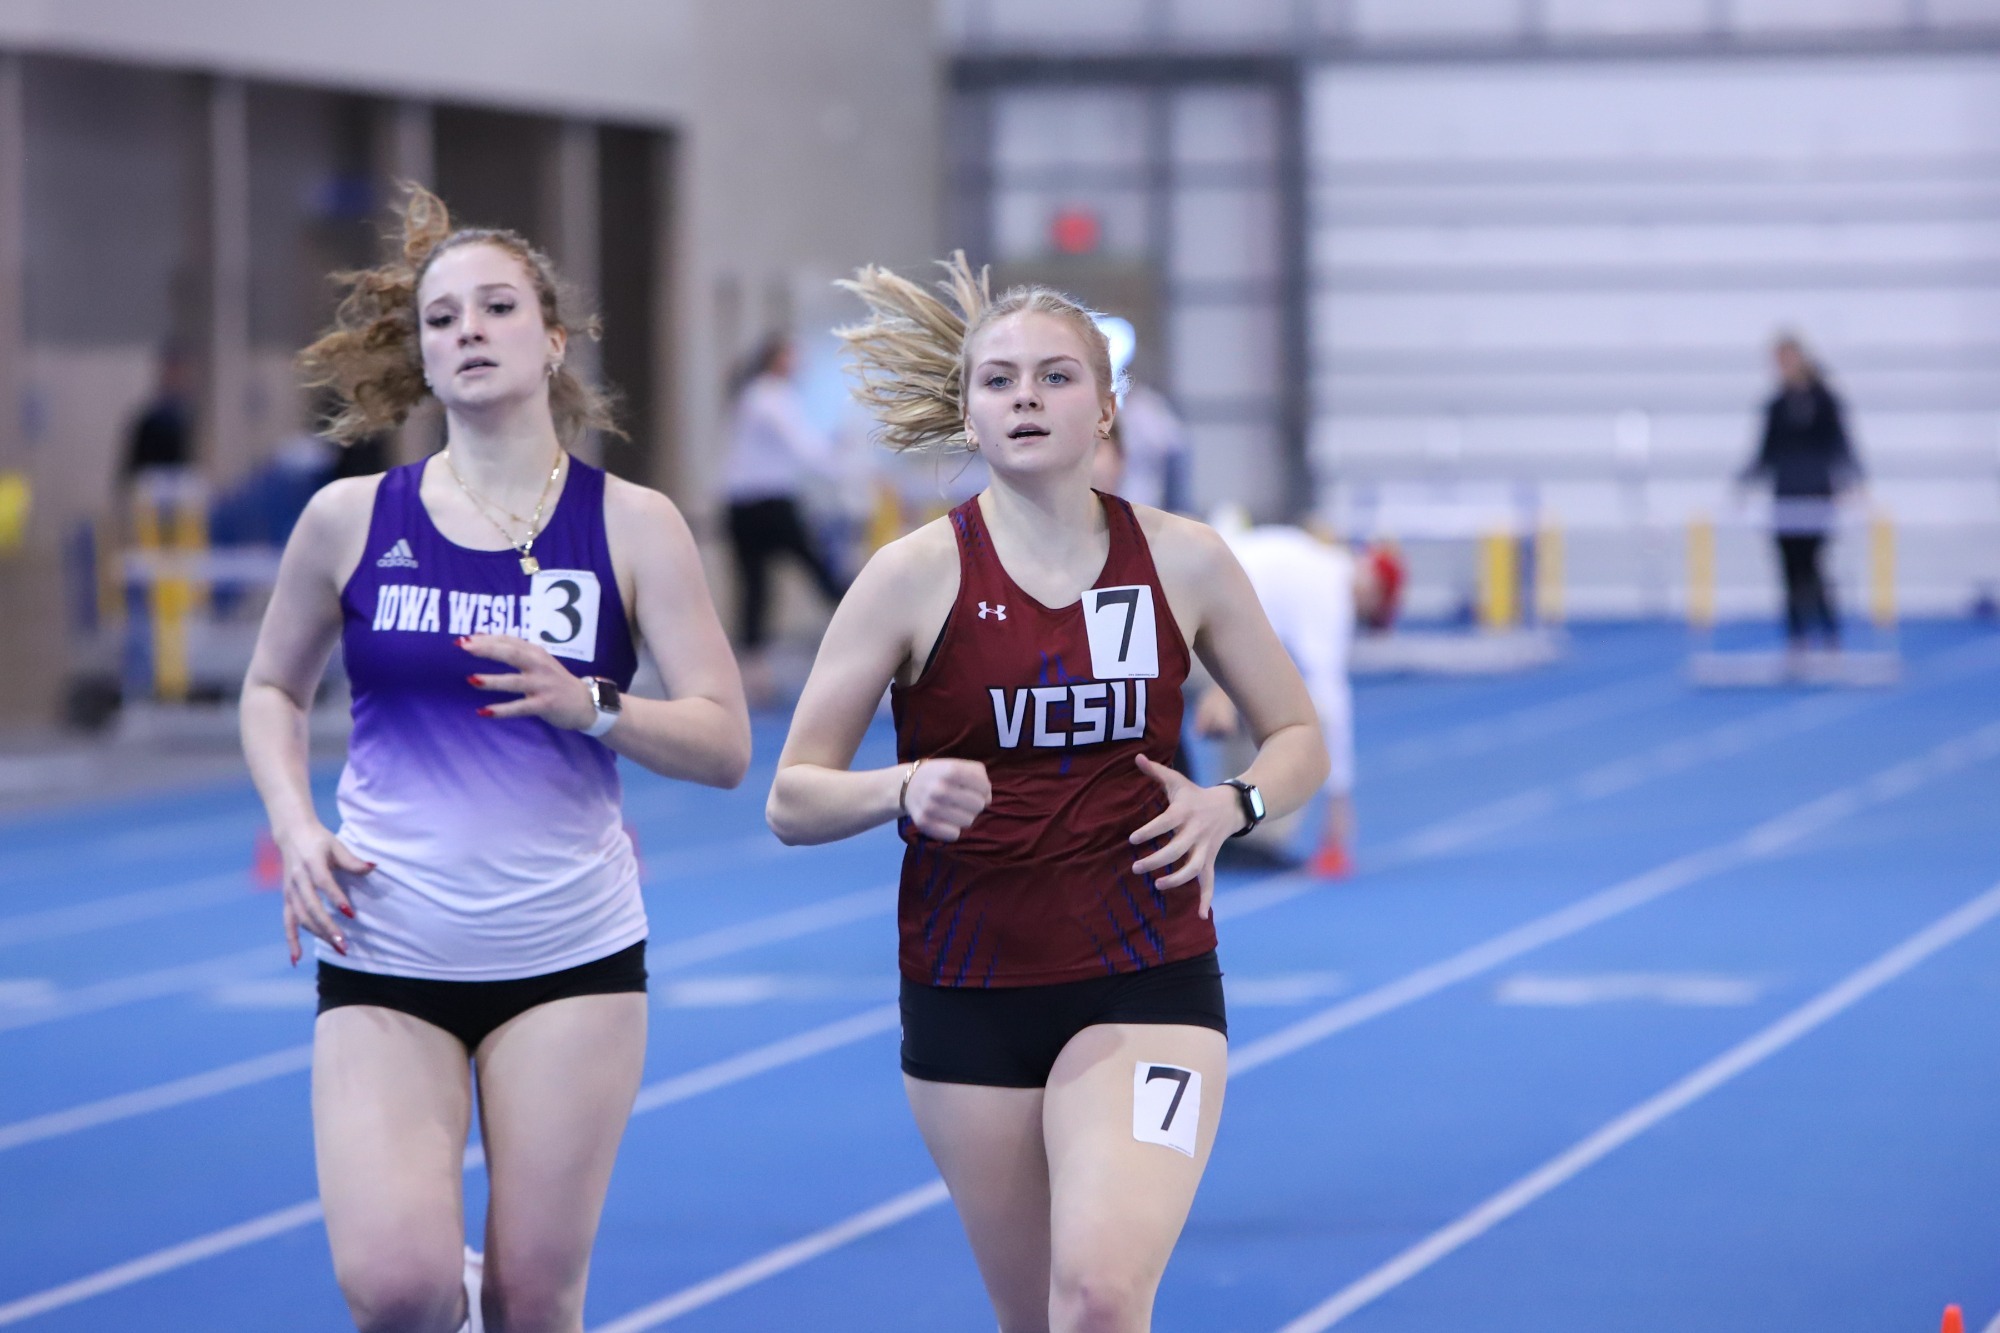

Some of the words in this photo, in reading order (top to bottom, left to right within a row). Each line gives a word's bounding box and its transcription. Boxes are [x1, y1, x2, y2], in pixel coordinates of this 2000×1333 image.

[376, 558, 419, 569] adidas
[372, 584, 441, 633] IOWA
[540, 579, 582, 644] 3
[1095, 588, 1140, 662] 7
[988, 679, 1147, 748] VCSU
[1145, 1065, 1192, 1132] 7
